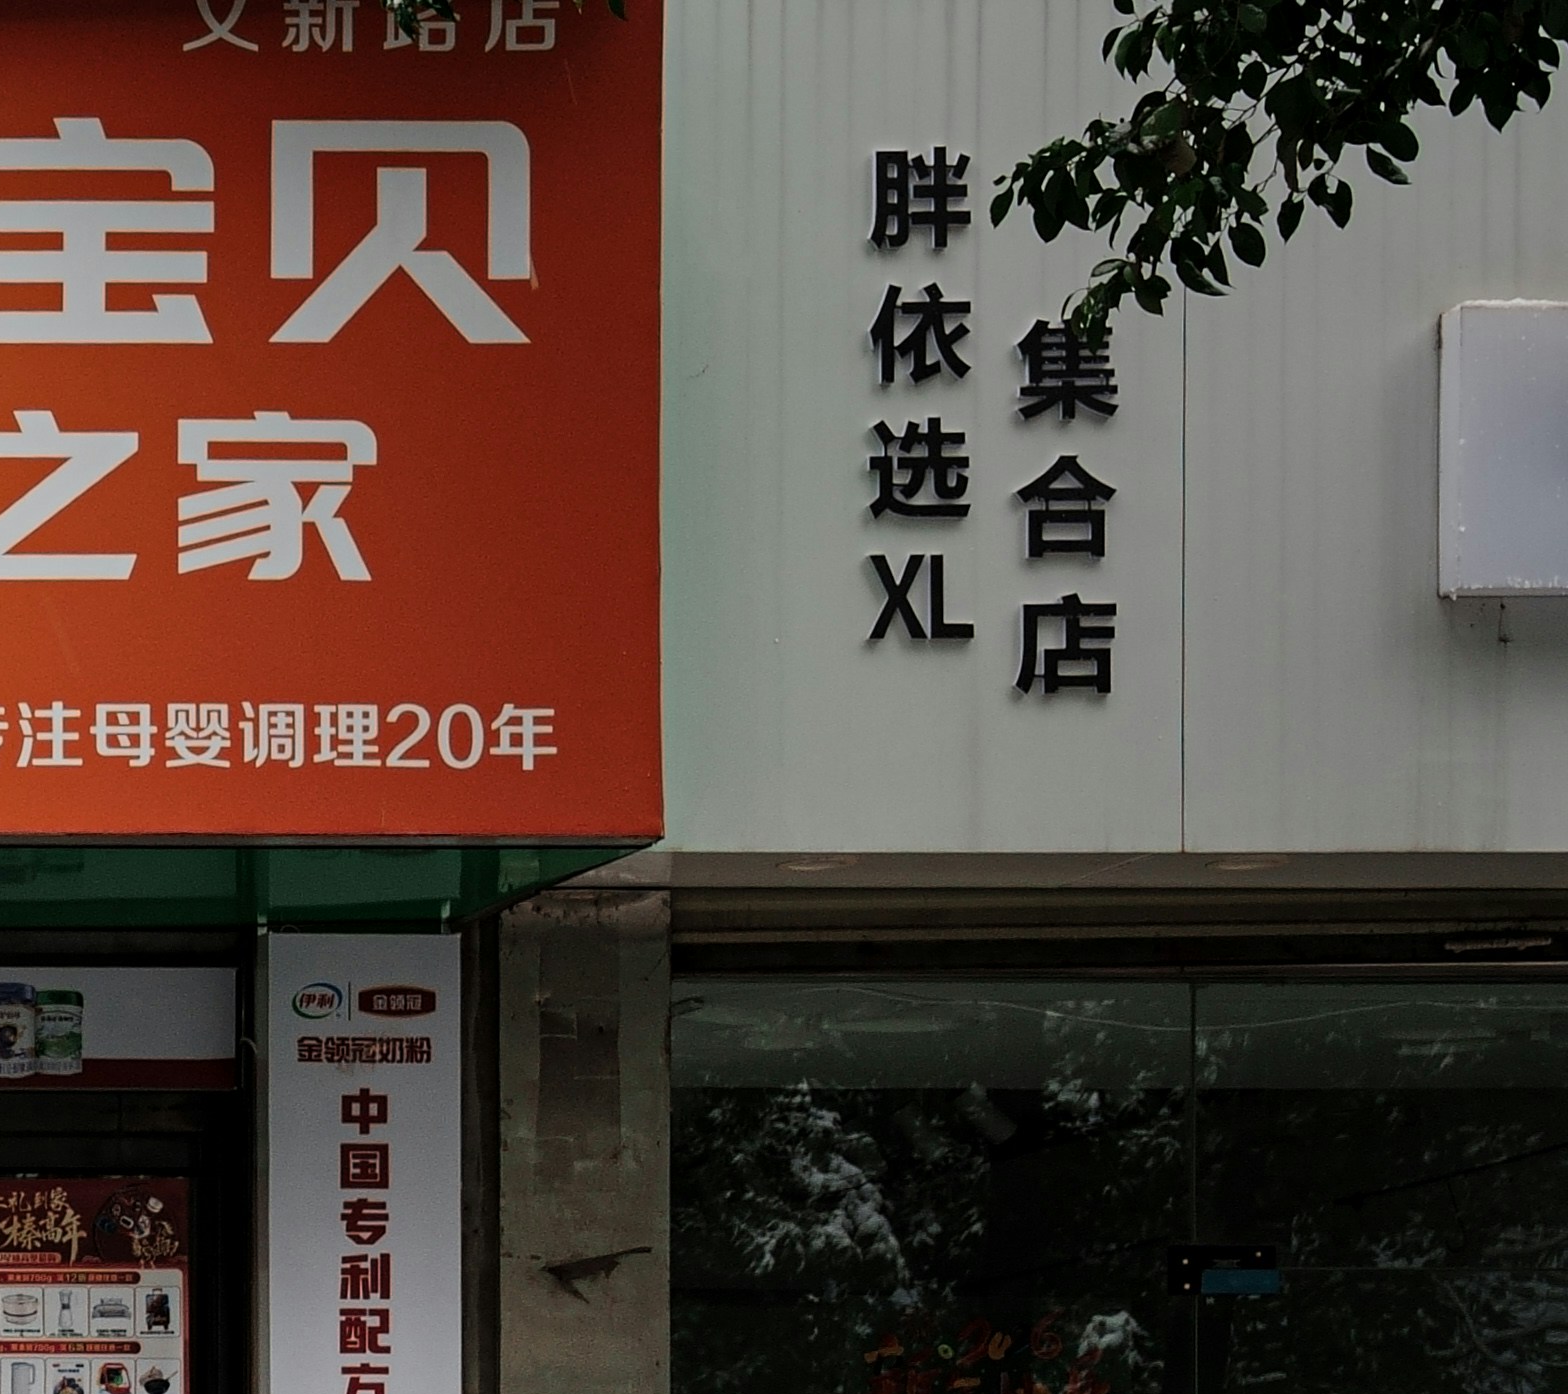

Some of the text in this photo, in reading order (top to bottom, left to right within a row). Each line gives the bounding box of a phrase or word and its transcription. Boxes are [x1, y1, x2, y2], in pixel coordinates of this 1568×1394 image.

[868, 146, 975, 641] 胖依选XL
[1015, 318, 1120, 696] 集合店
[296, 1037, 432, 1064] 金领冠奶粉
[298, 991, 423, 1012] 伊利 金领冠
